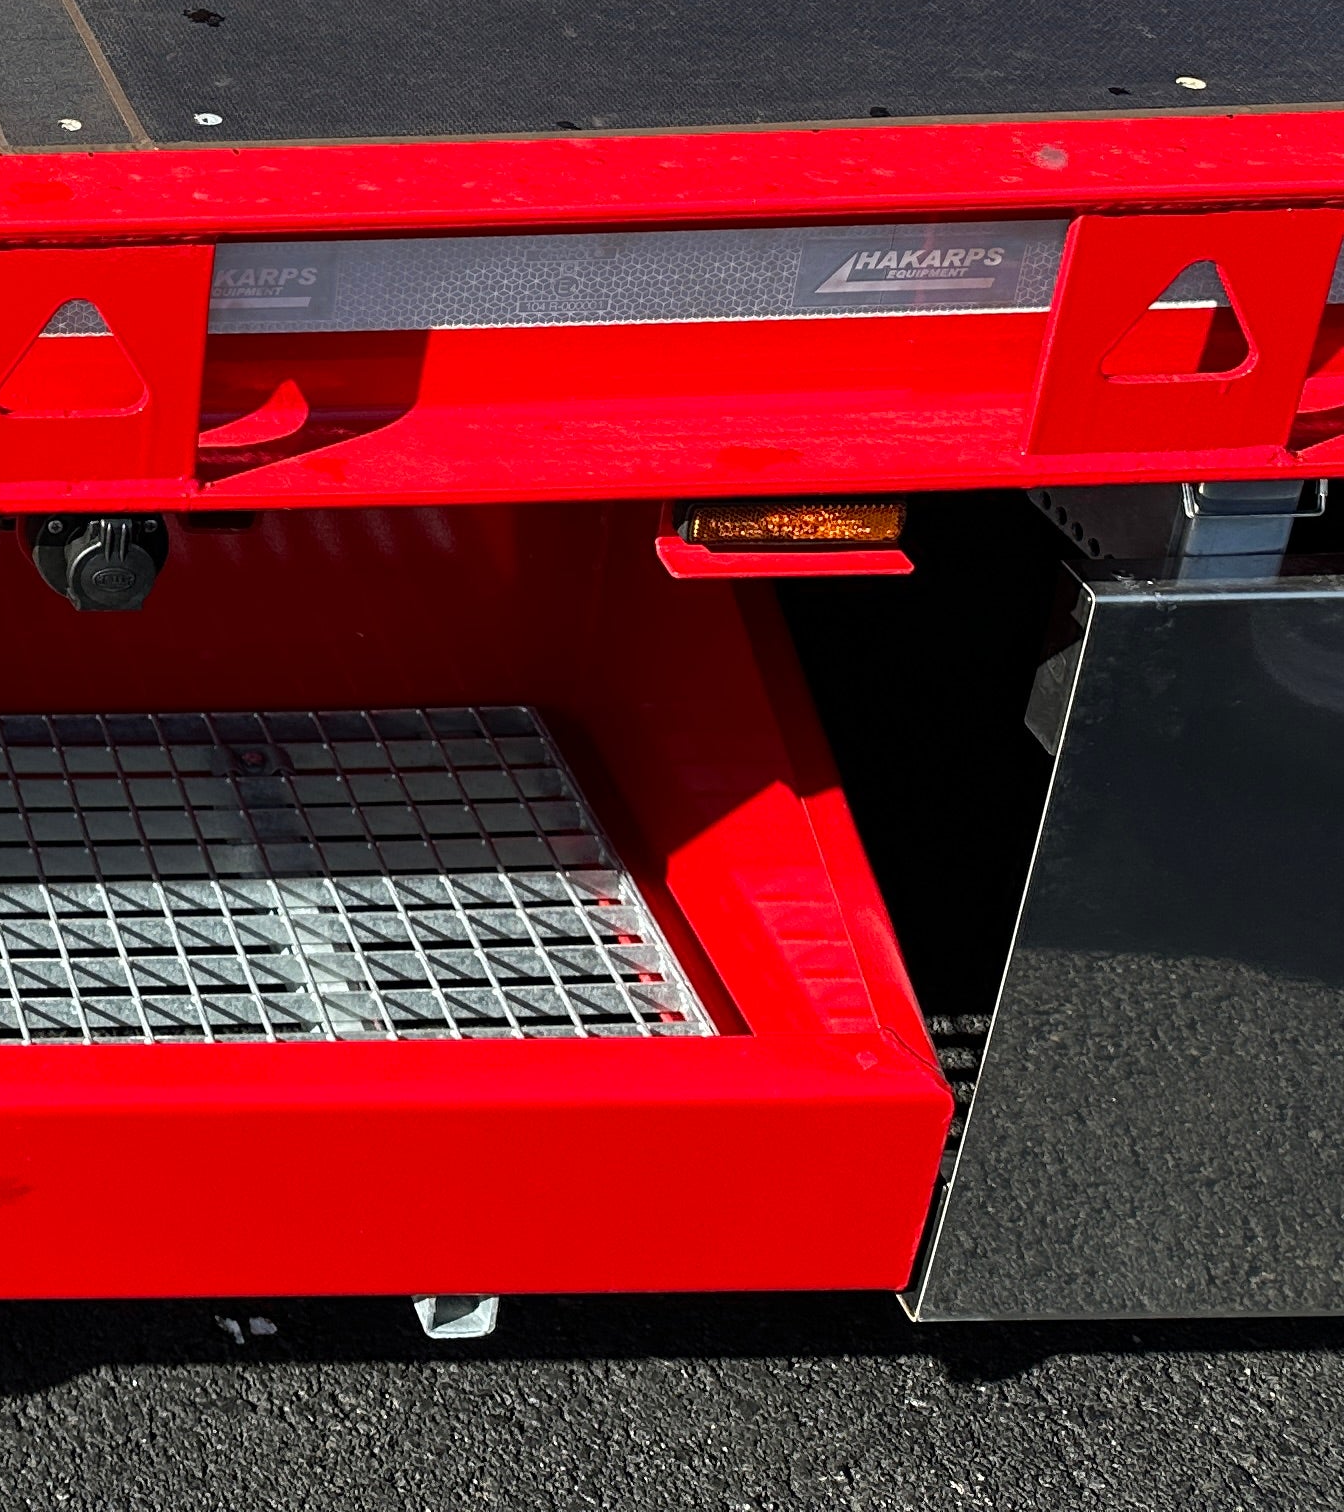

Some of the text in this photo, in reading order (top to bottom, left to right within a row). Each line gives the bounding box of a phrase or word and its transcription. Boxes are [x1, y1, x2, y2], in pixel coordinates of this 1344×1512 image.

[853, 247, 1005, 270] HAKARPS
[214, 267, 318, 287] KARPS
[885, 268, 969, 279] EQUIPMENT
[212, 286, 284, 297] QUIPMENT
